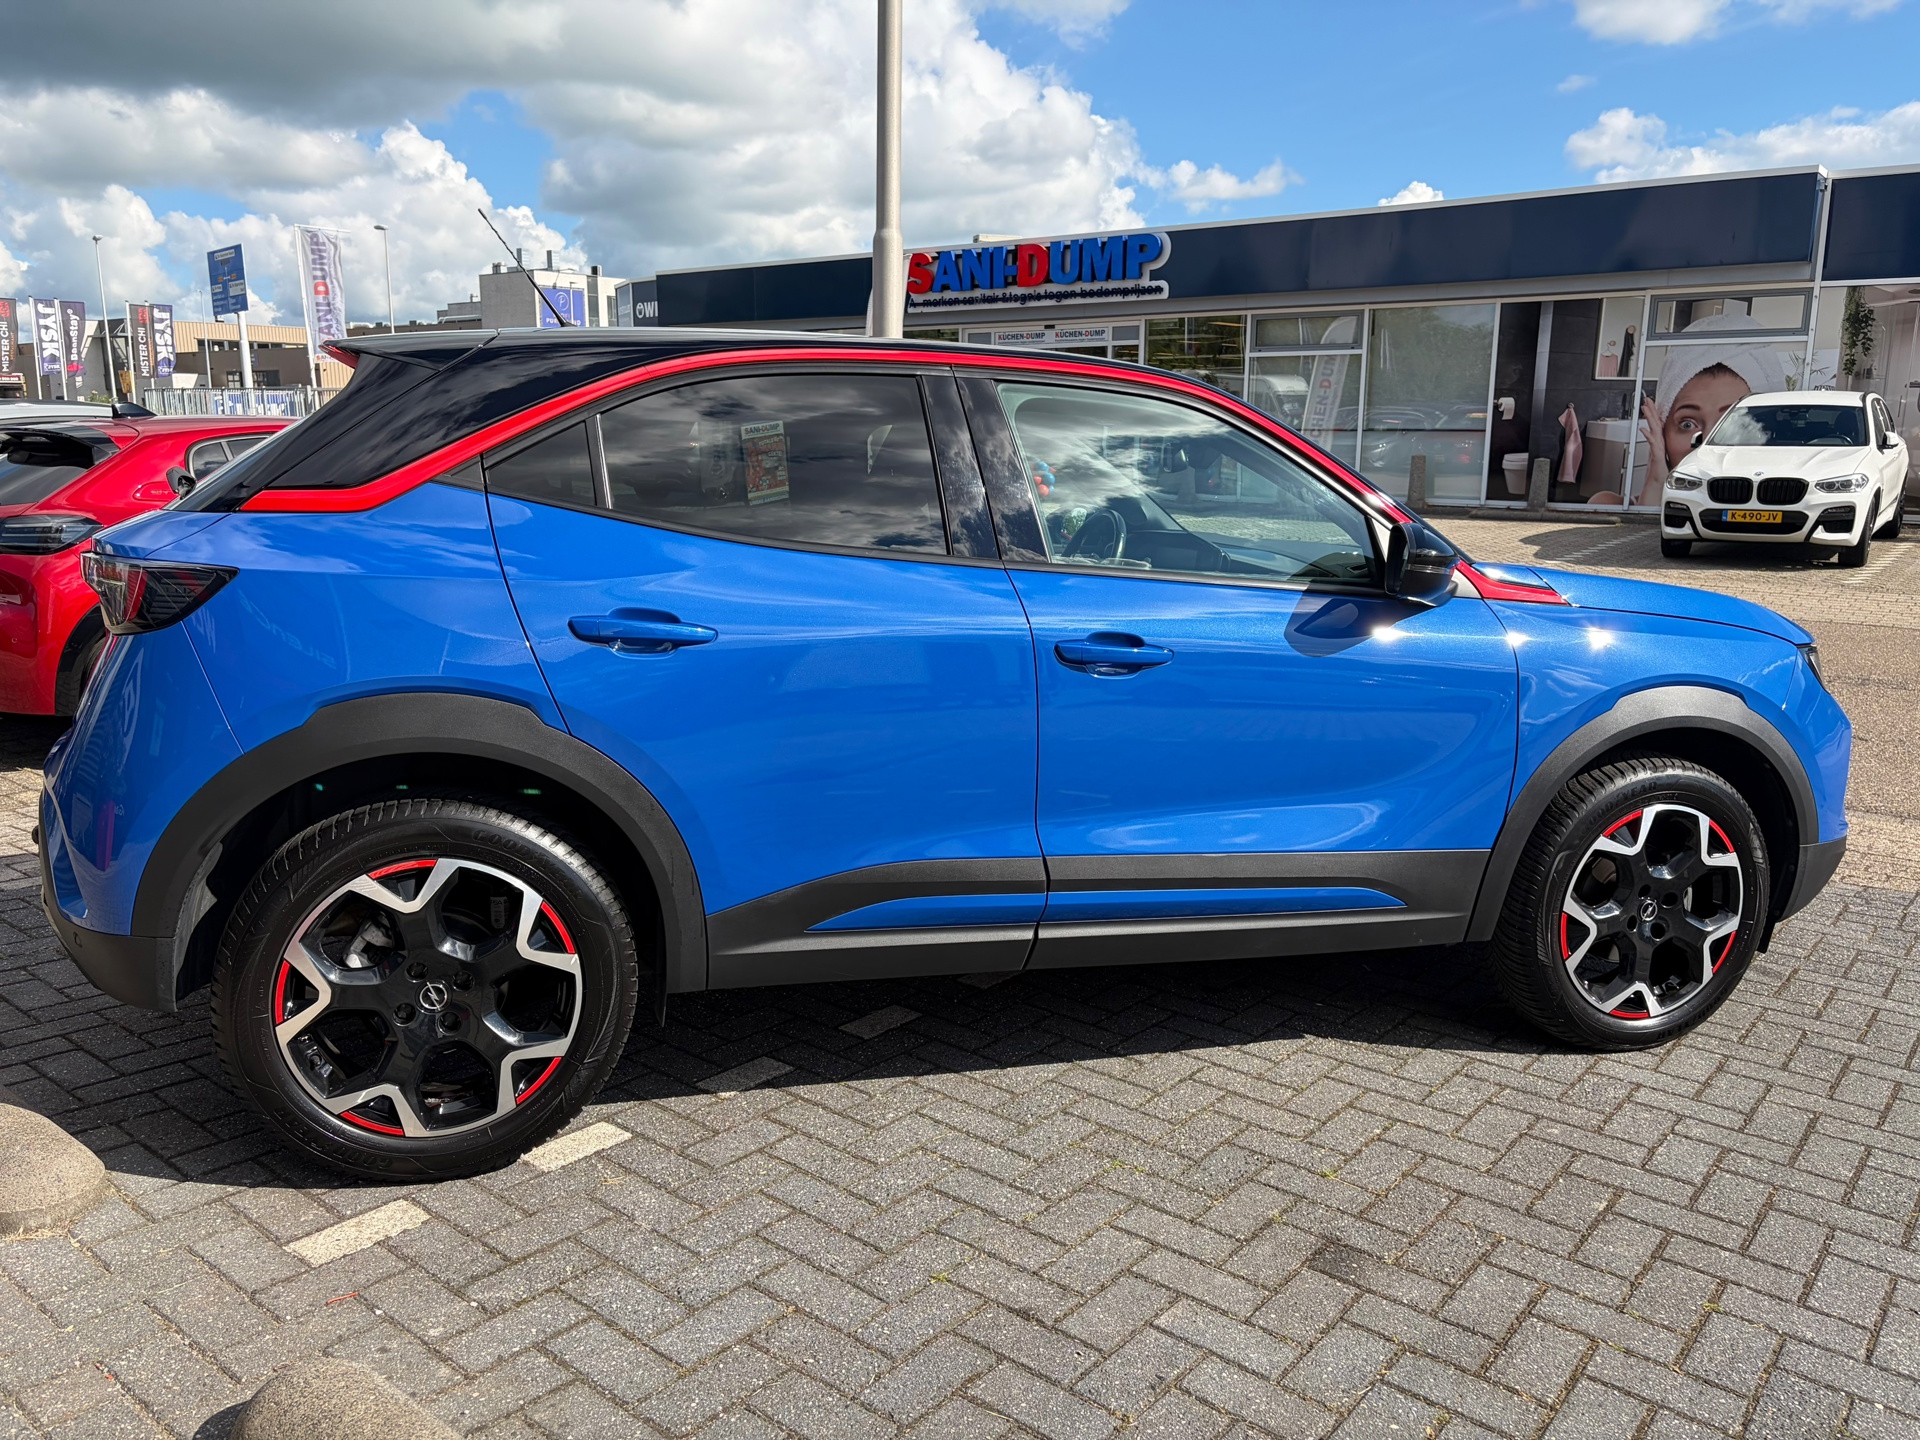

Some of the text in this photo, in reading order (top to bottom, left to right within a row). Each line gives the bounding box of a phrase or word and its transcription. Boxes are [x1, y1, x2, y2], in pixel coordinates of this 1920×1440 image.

[907, 232, 1163, 295] SANI-DUMP
[309, 232, 335, 341] ANI-DUMP
[1080, 283, 1164, 299] bodemprijzen
[0, 321, 9, 337] CHI
[37, 303, 60, 358] JYSK
[138, 327, 147, 343] CHI
[154, 308, 175, 362] JYSK
[998, 331, 1046, 341] KÜCHEN-DUMP
[1055, 329, 1106, 339] KÜCHEN-DUMP
[1, 340, 10, 372] MISTER
[139, 345, 150, 377] MISTER
[744, 423, 780, 434] SANI-DUMP
[1731, 511, 1778, 521] K-490-JV
